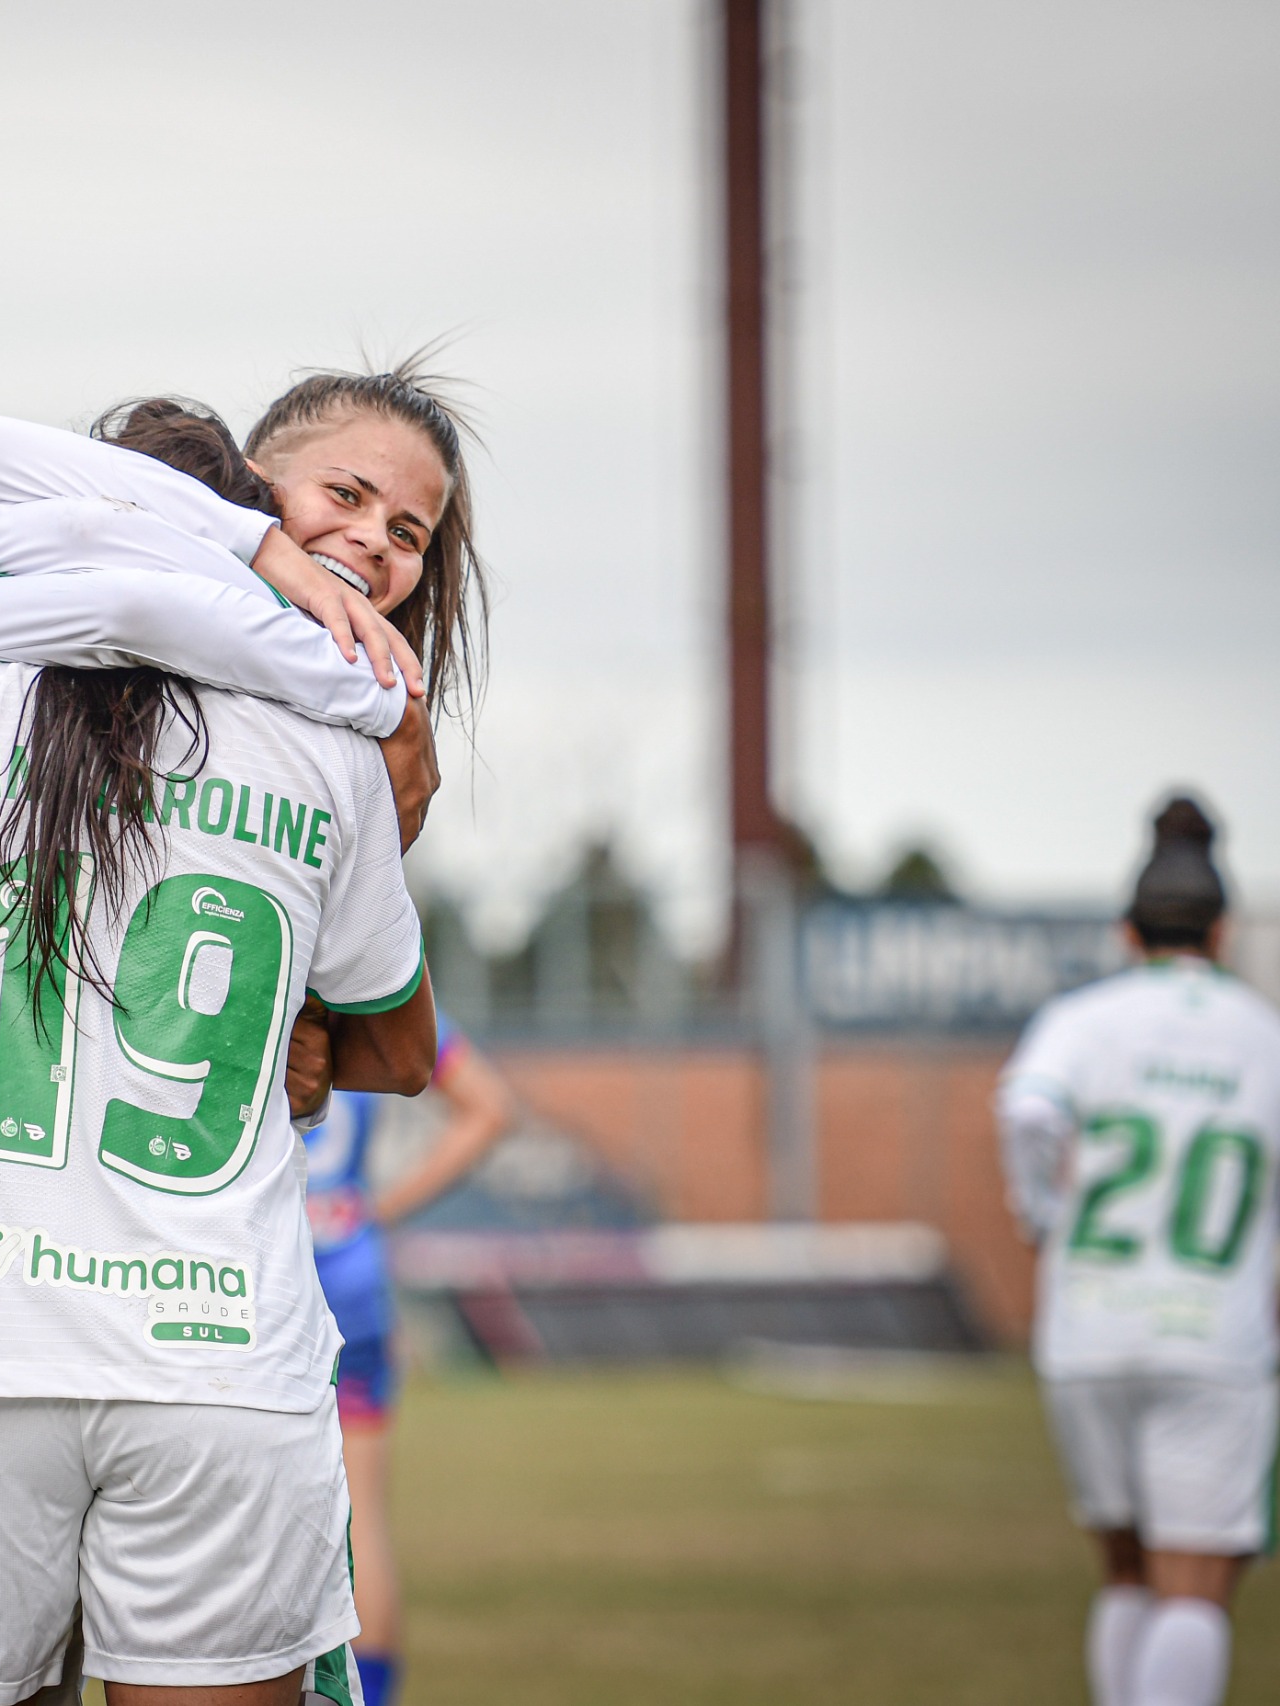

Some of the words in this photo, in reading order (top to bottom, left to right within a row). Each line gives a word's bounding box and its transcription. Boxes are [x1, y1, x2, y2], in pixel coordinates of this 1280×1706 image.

[202, 902, 245, 918] EFFICIENZA
[1070, 1116, 1264, 1273] 20
[30, 1234, 247, 1298] humana
[154, 1301, 249, 1320] SAÚDE
[182, 1326, 223, 1340] SUL
